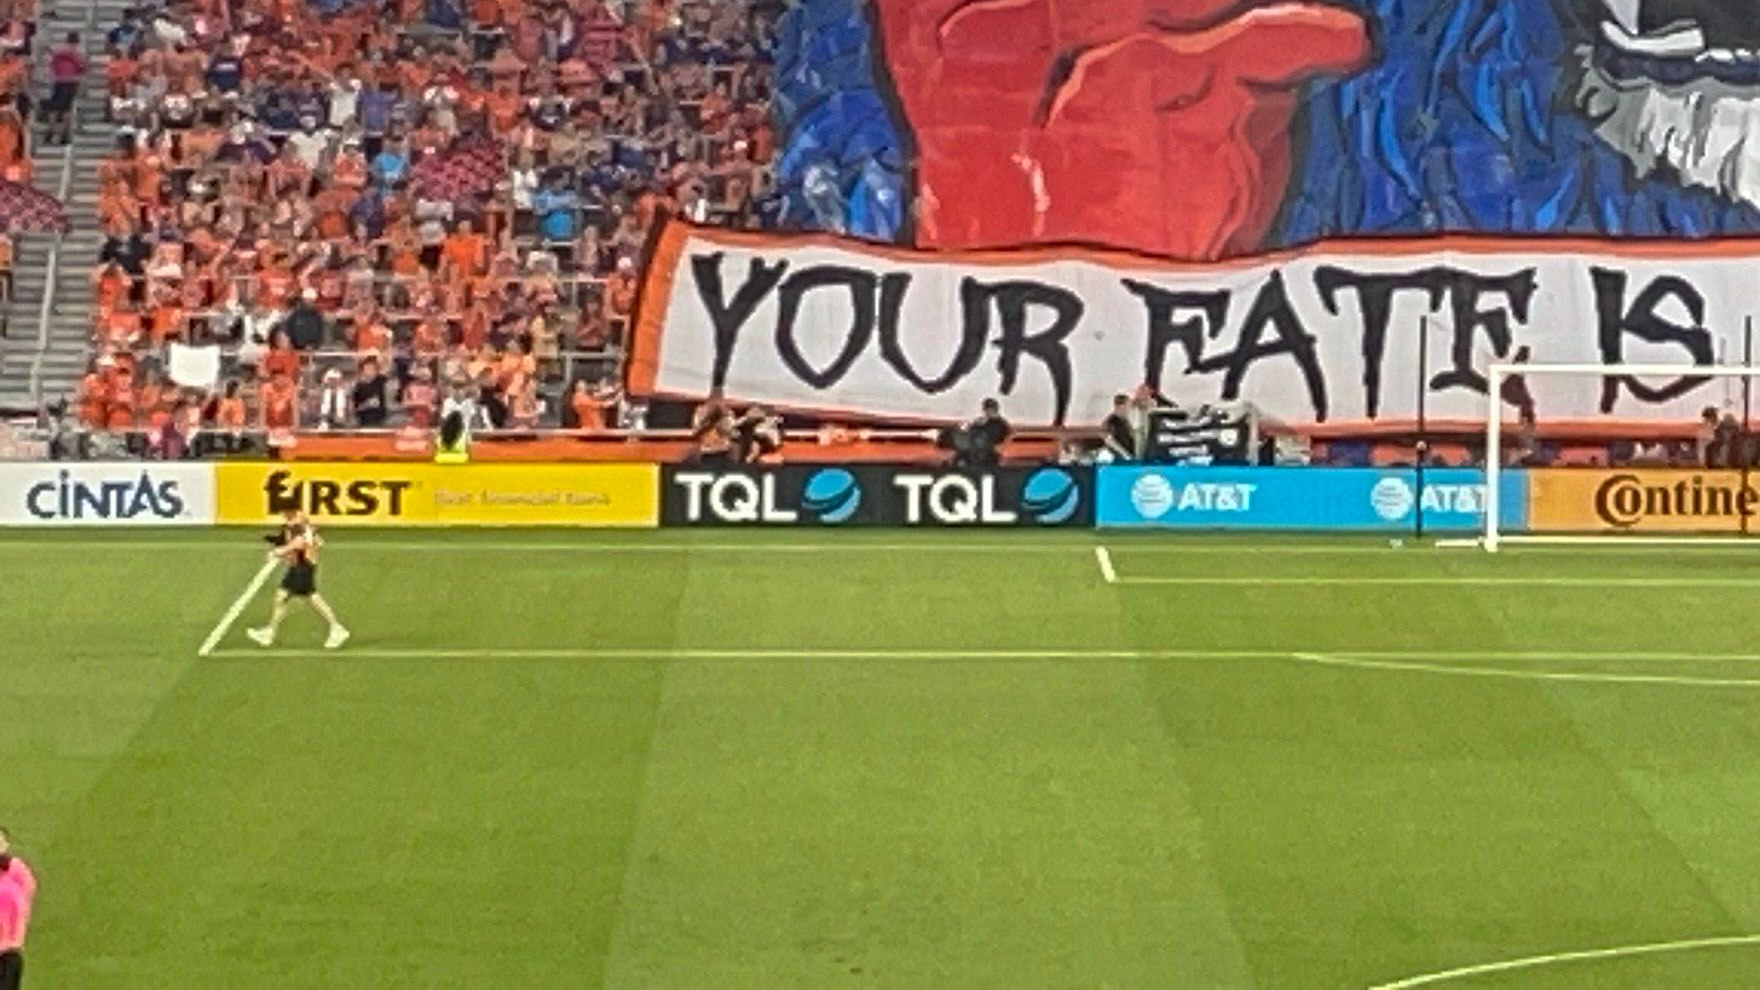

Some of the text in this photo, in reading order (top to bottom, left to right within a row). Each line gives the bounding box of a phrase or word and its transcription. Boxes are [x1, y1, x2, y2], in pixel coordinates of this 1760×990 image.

[691, 252, 1085, 426] YOUR
[1122, 266, 1536, 422] FATE
[1590, 266, 1713, 414] IS
[675, 473, 798, 522] TQL
[894, 474, 1018, 523] TQL
[1178, 482, 1258, 511] AT&T
